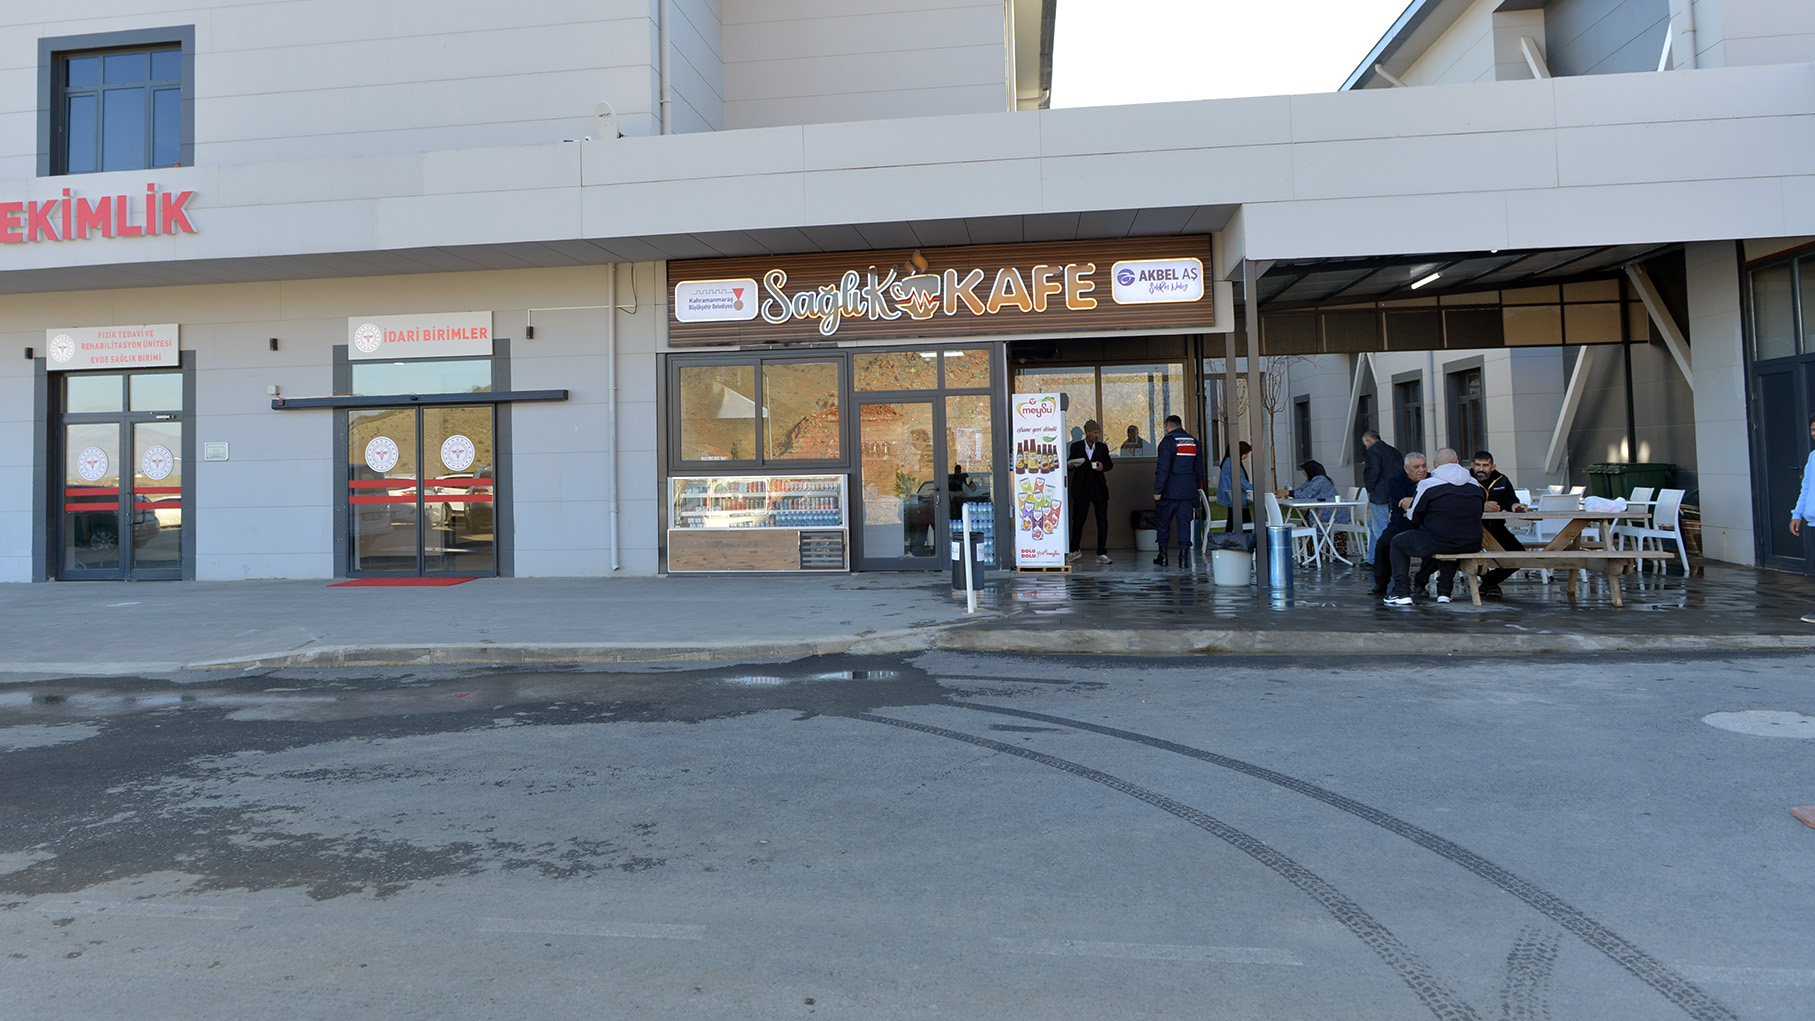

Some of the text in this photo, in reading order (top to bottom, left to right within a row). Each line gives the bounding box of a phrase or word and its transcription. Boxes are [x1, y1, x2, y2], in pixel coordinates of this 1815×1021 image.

[1139, 267, 1198, 281] AKBEL AŞ
[943, 262, 1098, 317] KAFE
[97, 330, 117, 339] FİZİK
[118, 329, 144, 338] TEDAVİ
[383, 325, 488, 343] İDARİ BİRİMLER
[81, 338, 172, 350] REHABİLİTASYON ÜNİTESİ
[90, 352, 162, 363] EVDE SAĞLIK BİRİMİ
